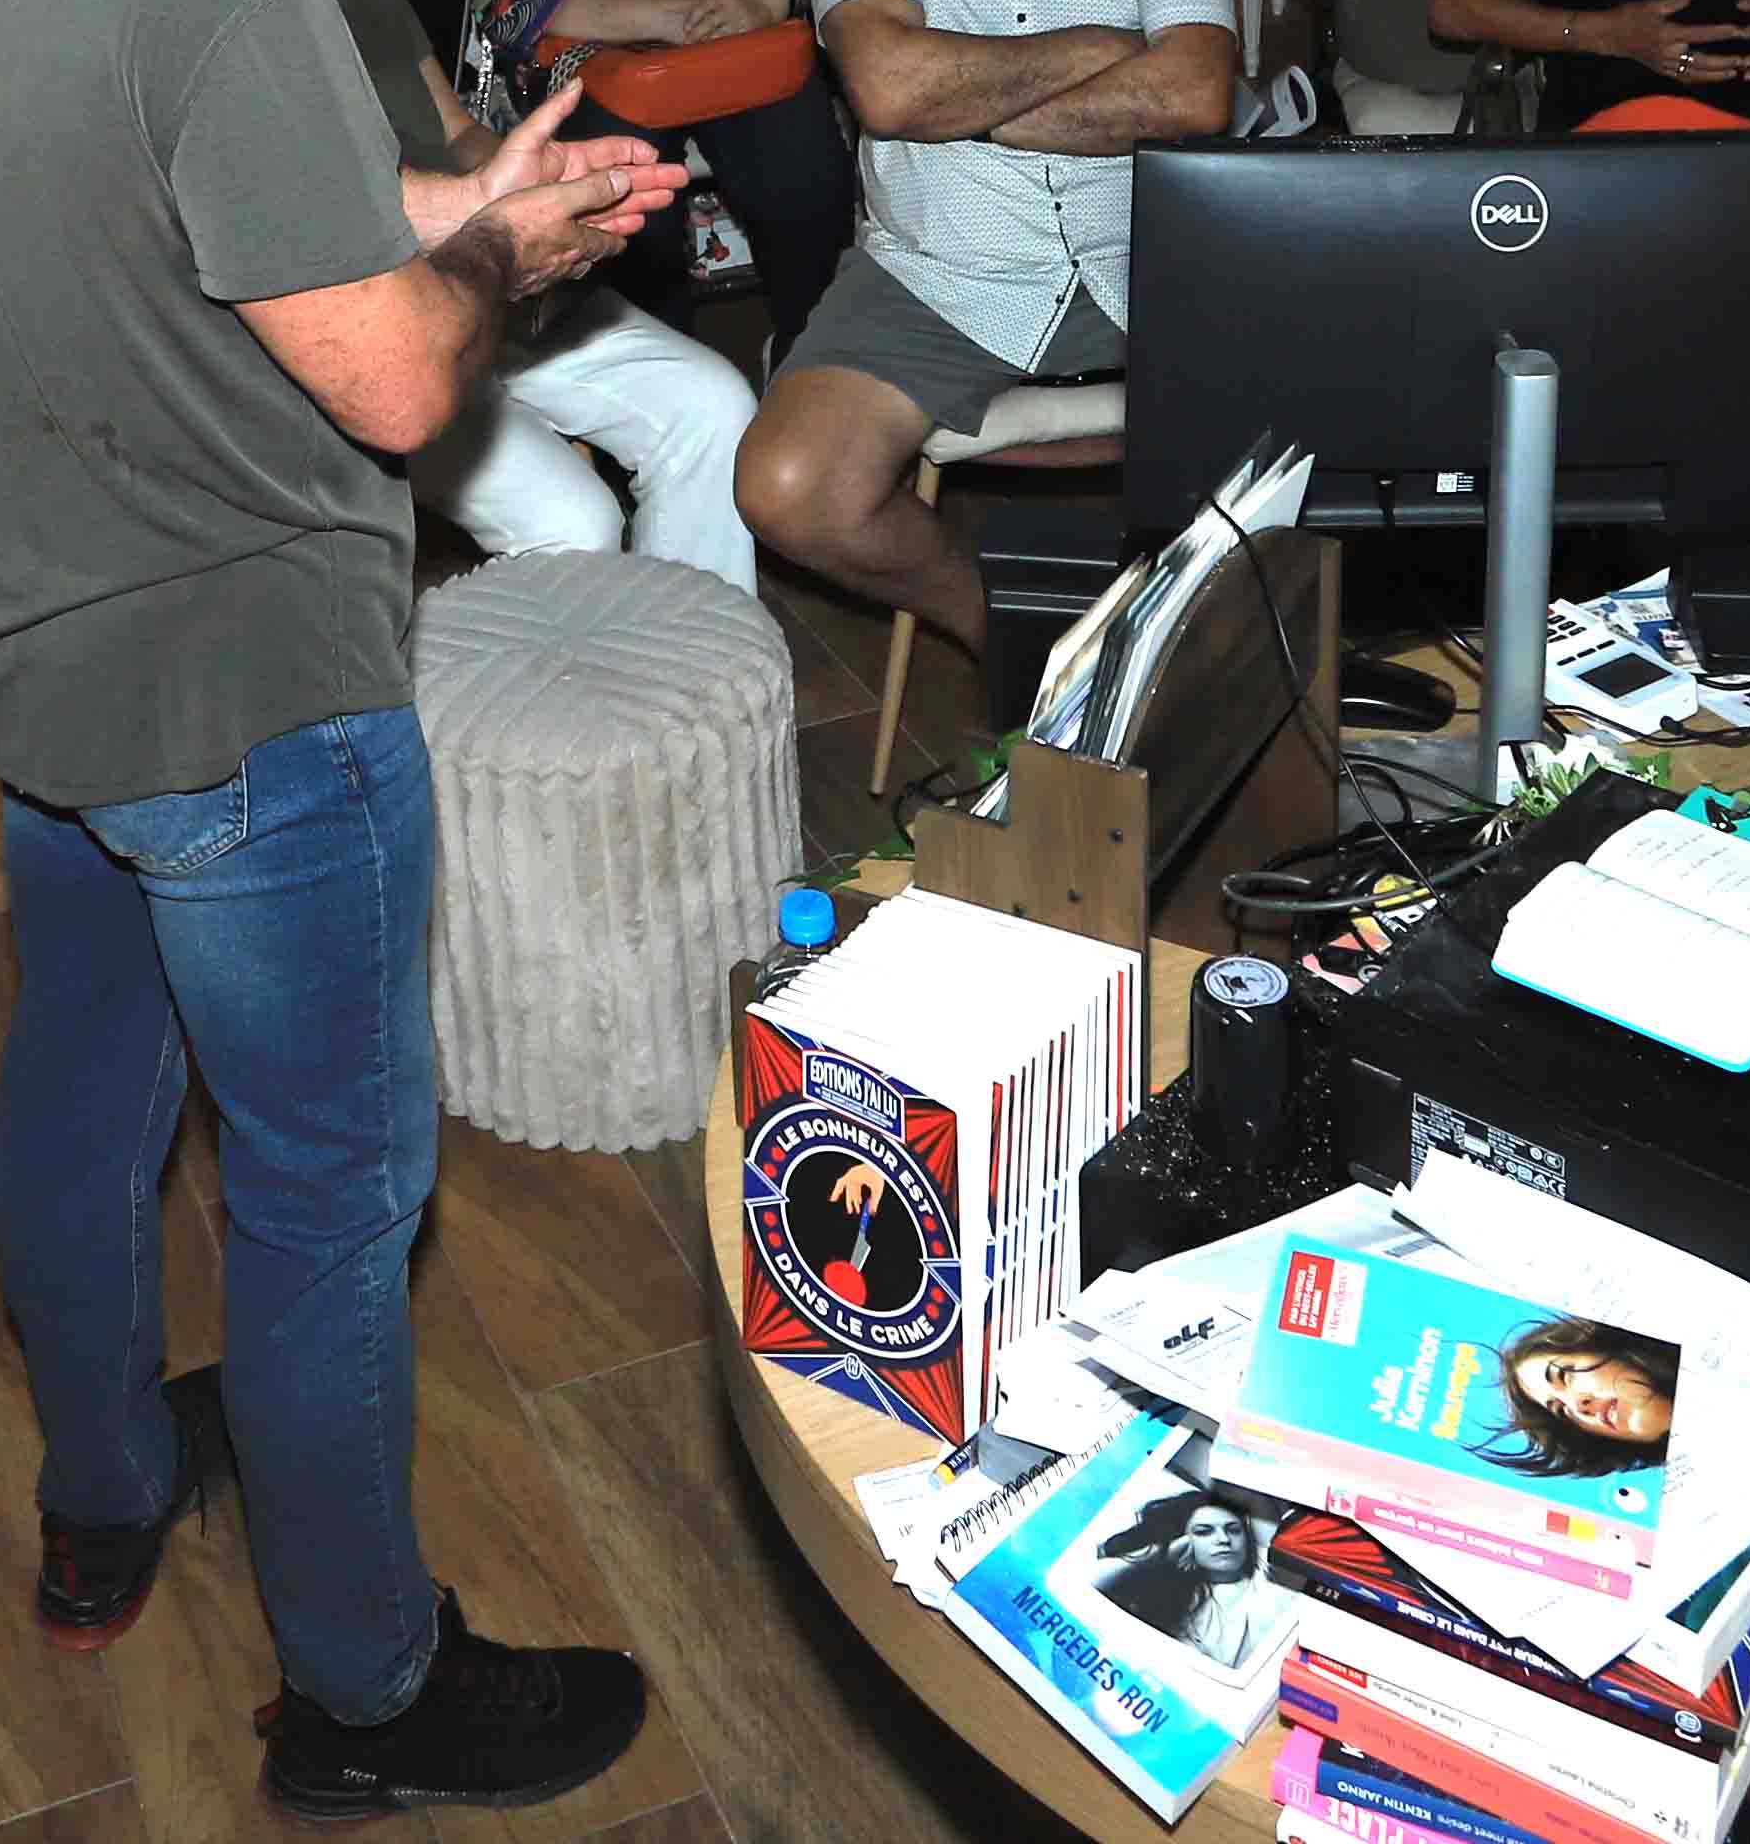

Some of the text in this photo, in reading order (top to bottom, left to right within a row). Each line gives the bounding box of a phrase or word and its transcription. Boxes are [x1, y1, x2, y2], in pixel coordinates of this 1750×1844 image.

[1480, 201, 1541, 227] DELL
[809, 1056, 864, 1100] ÉDITIONS
[882, 1095, 899, 1120] LU
[776, 1117, 935, 1217] LE BONHEUR EST
[774, 1251, 935, 1348] DANS LE CRIME
[1369, 1365, 1404, 1423] Julia
[1396, 1599, 1437, 1628] CRIME
[1436, 1611, 1455, 1633] LE
[1452, 1619, 1490, 1647] DANS
[1011, 1584, 1171, 1736] MERCEDES RON
[1337, 1779, 1384, 1808] JARNO
[1381, 1793, 1433, 1822] KENTIN
